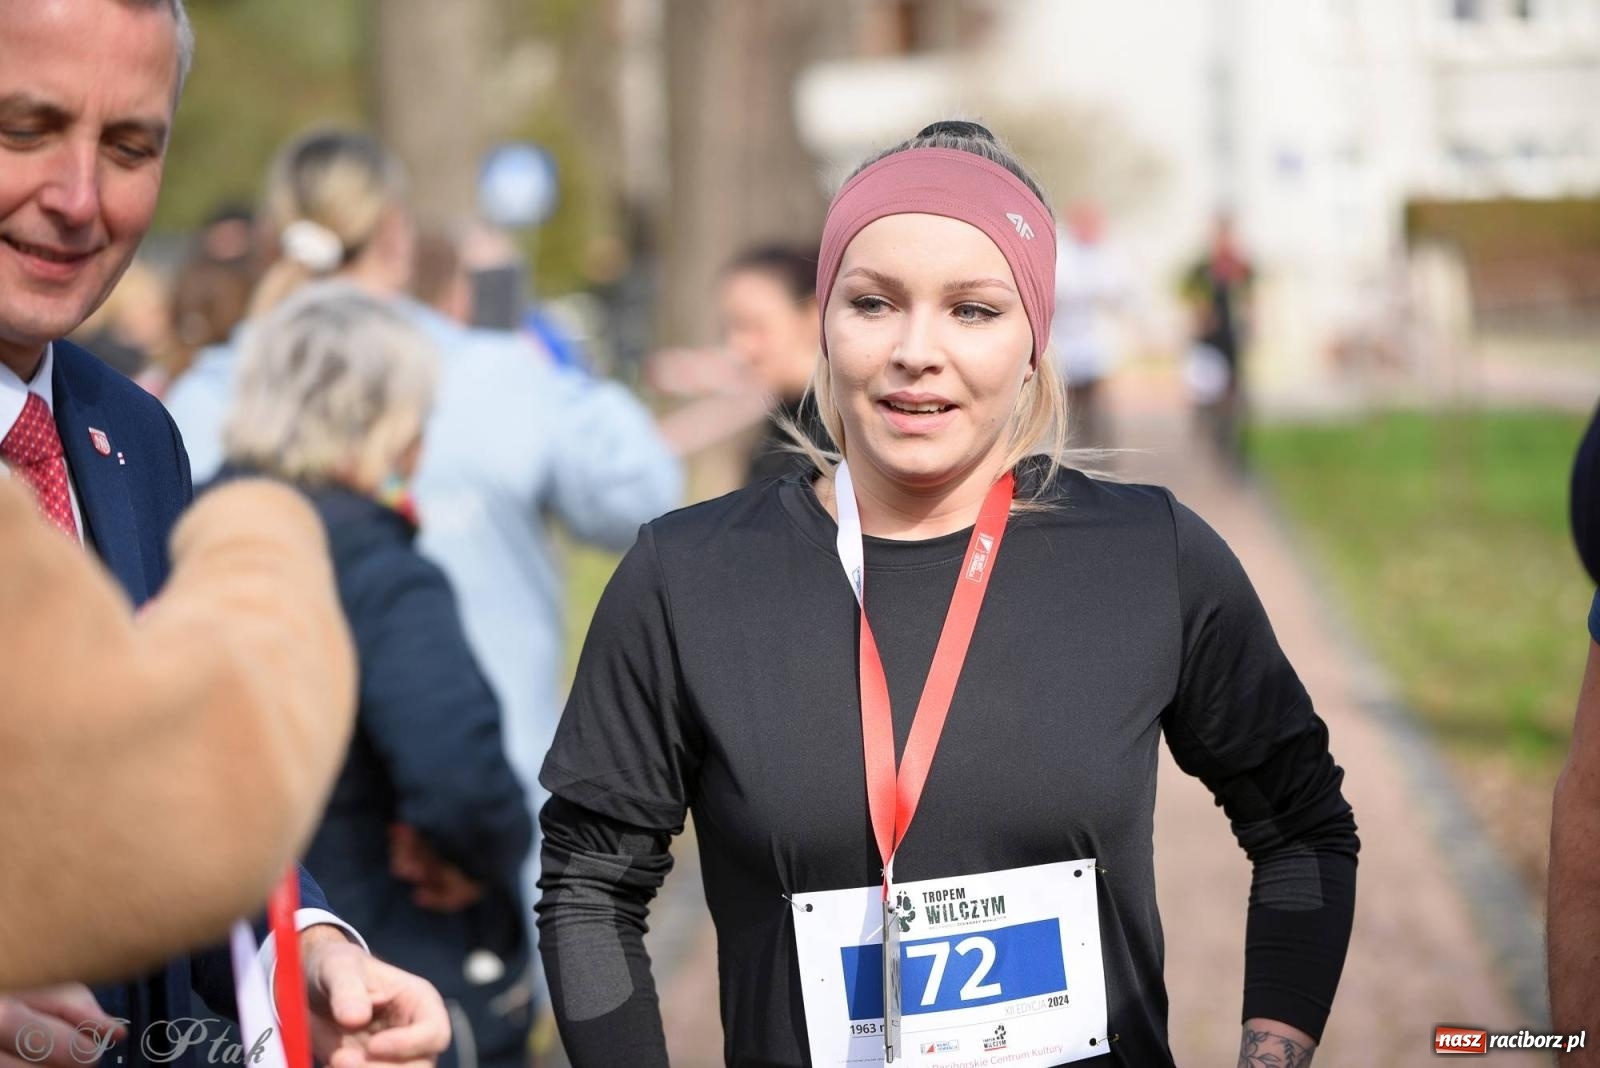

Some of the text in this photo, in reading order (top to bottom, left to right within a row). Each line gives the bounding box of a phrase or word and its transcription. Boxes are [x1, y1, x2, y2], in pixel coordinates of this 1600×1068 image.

[922, 887, 965, 903] TROPEM
[925, 895, 1006, 925] WILCZYM
[905, 936, 1001, 1006] 72
[1047, 994, 1069, 1008] 2024
[850, 1023, 876, 1035] 1963
[990, 1050, 1030, 1065] Centrum
[1031, 1044, 1063, 1058] Kultury
